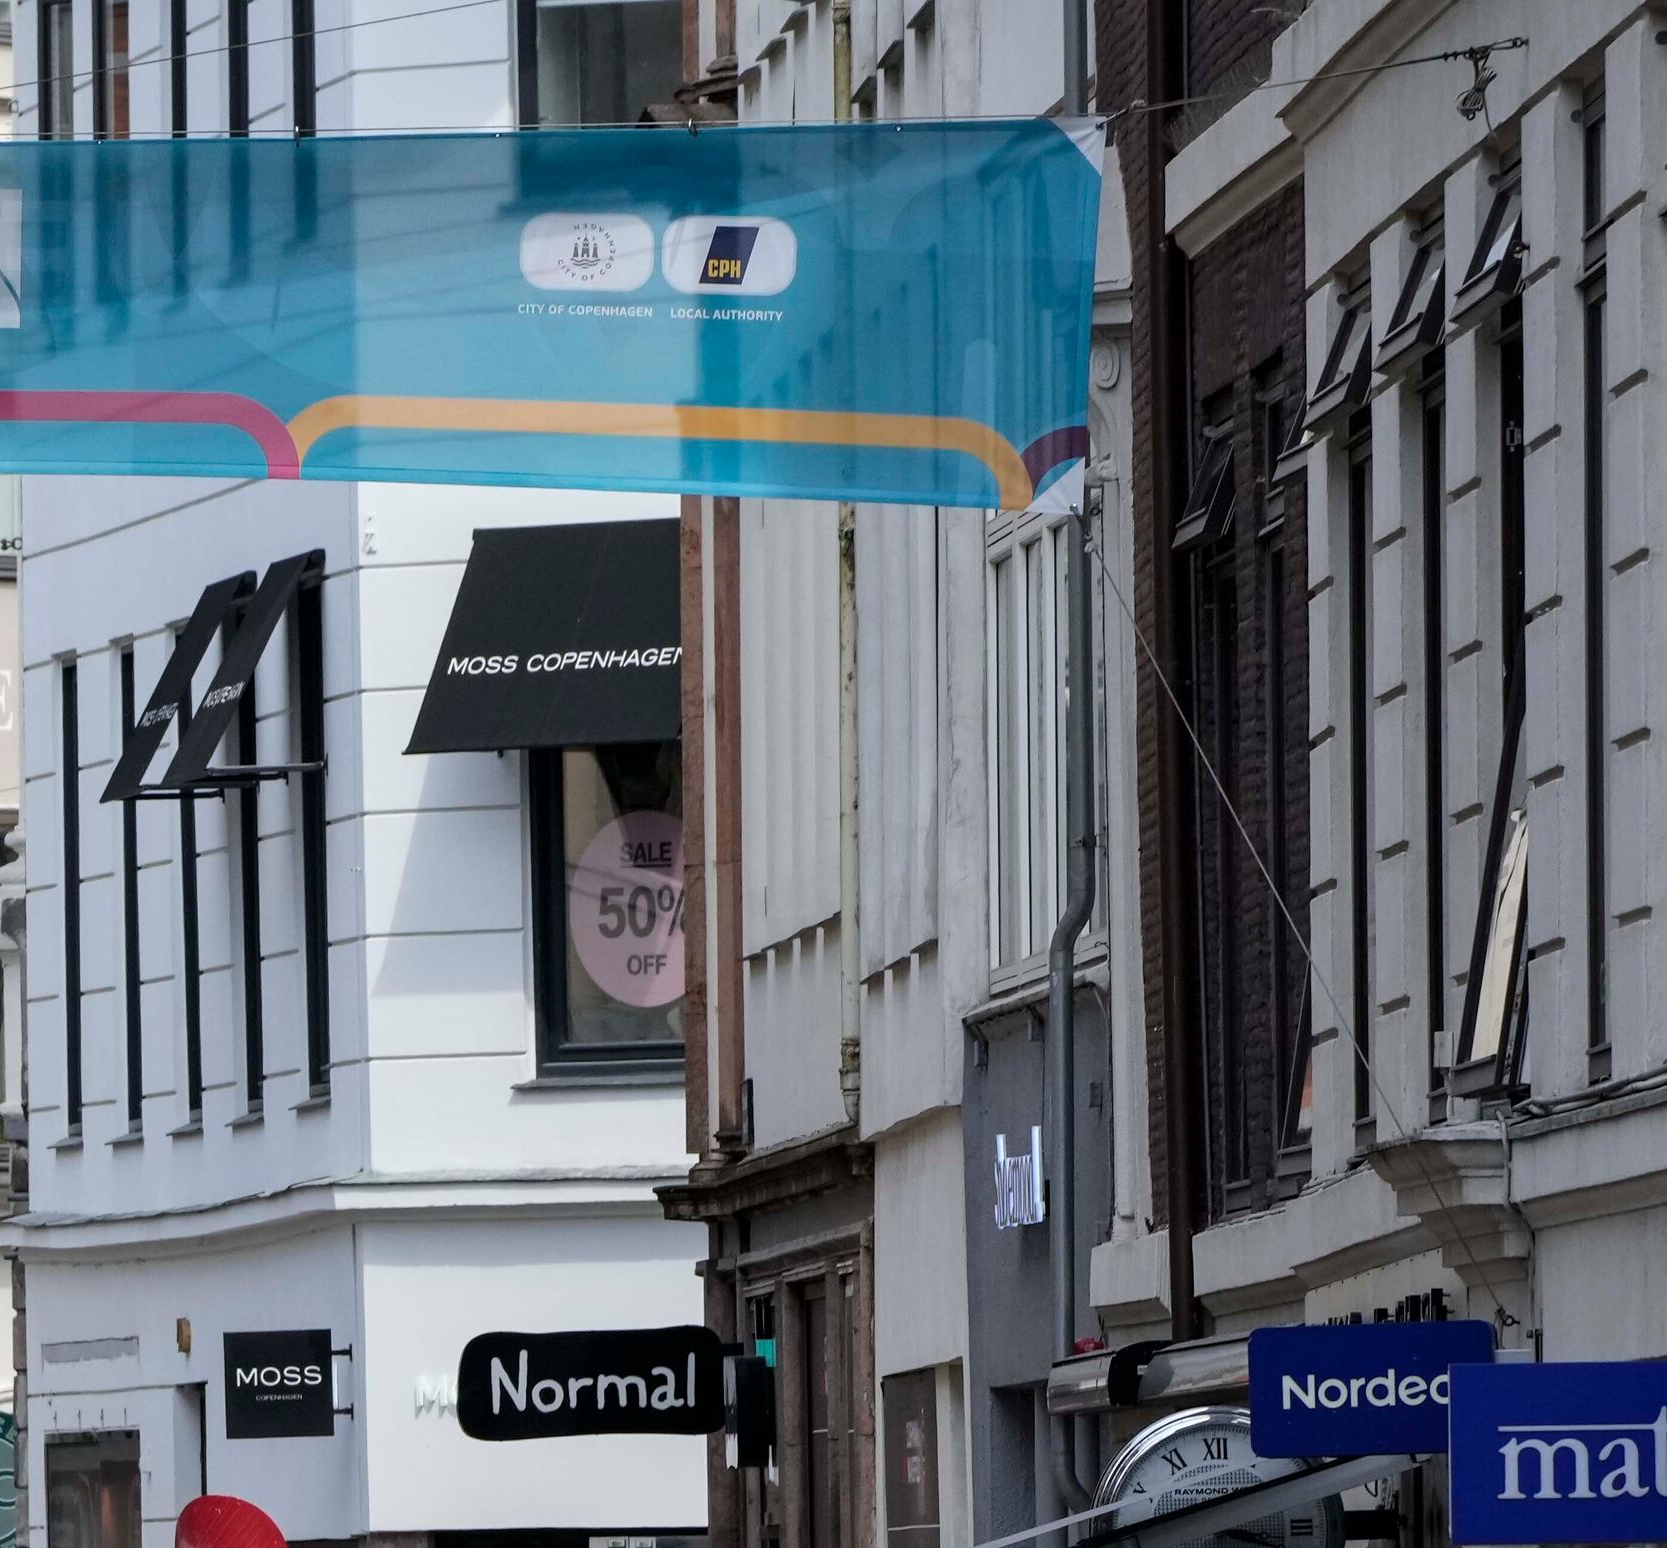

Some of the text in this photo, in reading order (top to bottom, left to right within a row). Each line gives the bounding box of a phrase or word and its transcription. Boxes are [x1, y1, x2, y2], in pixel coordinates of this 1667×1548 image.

[708, 259, 741, 280] CPH
[517, 303, 653, 318] CITY OF COPENHAGEN
[670, 308, 784, 322] LOCAL AUTHORITY
[447, 652, 519, 675] MOSS
[620, 842, 673, 868] SALE
[626, 954, 668, 976] OFF
[236, 1364, 324, 1388] MOSS
[489, 1349, 698, 1417] Normal
[1173, 1486, 1229, 1496] RAYMOND
